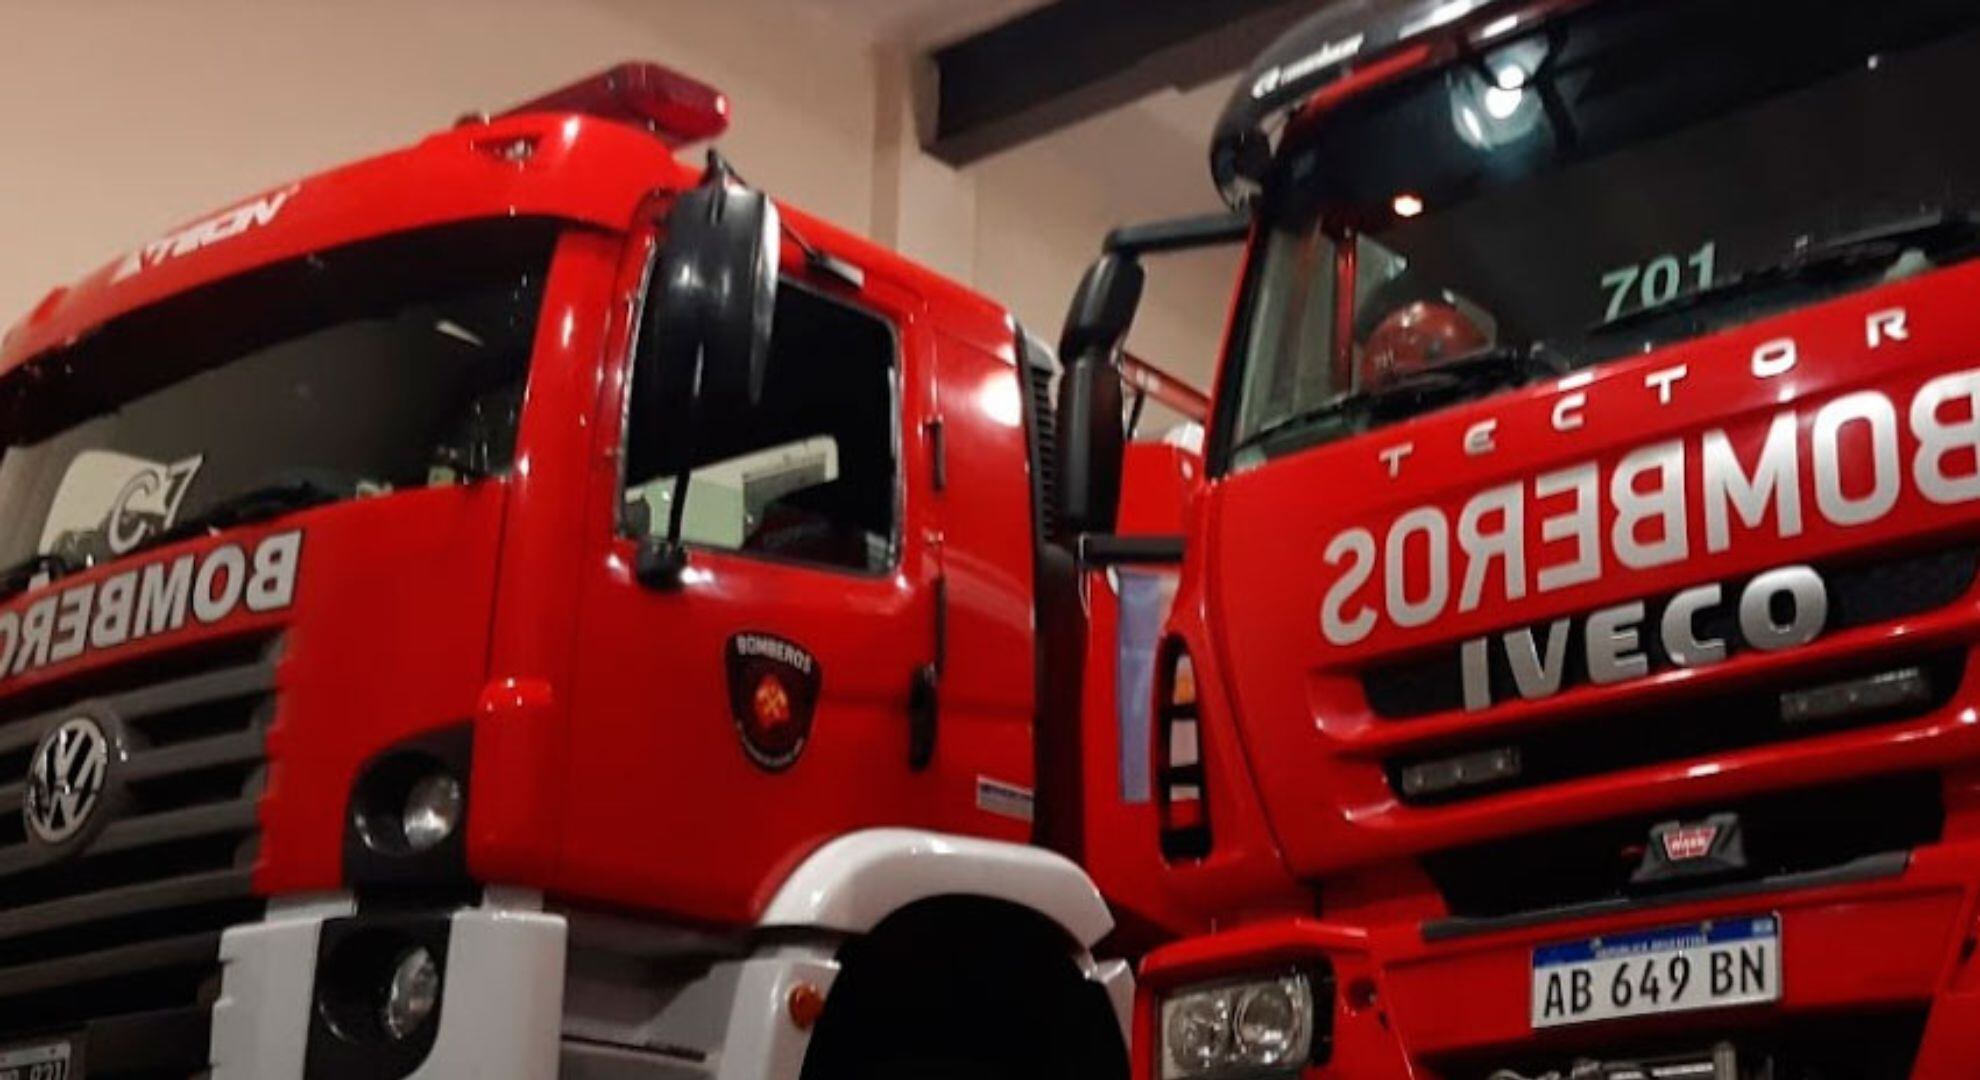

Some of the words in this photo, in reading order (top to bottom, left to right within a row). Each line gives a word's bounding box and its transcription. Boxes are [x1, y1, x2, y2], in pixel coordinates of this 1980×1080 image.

[1602, 241, 1715, 322] 701
[1379, 307, 1909, 478] TECTOR
[1460, 563, 1829, 712] IVECO
[1543, 968, 1592, 1018] AB
[1611, 956, 1690, 1008] 649
[1710, 944, 1765, 997] BN
